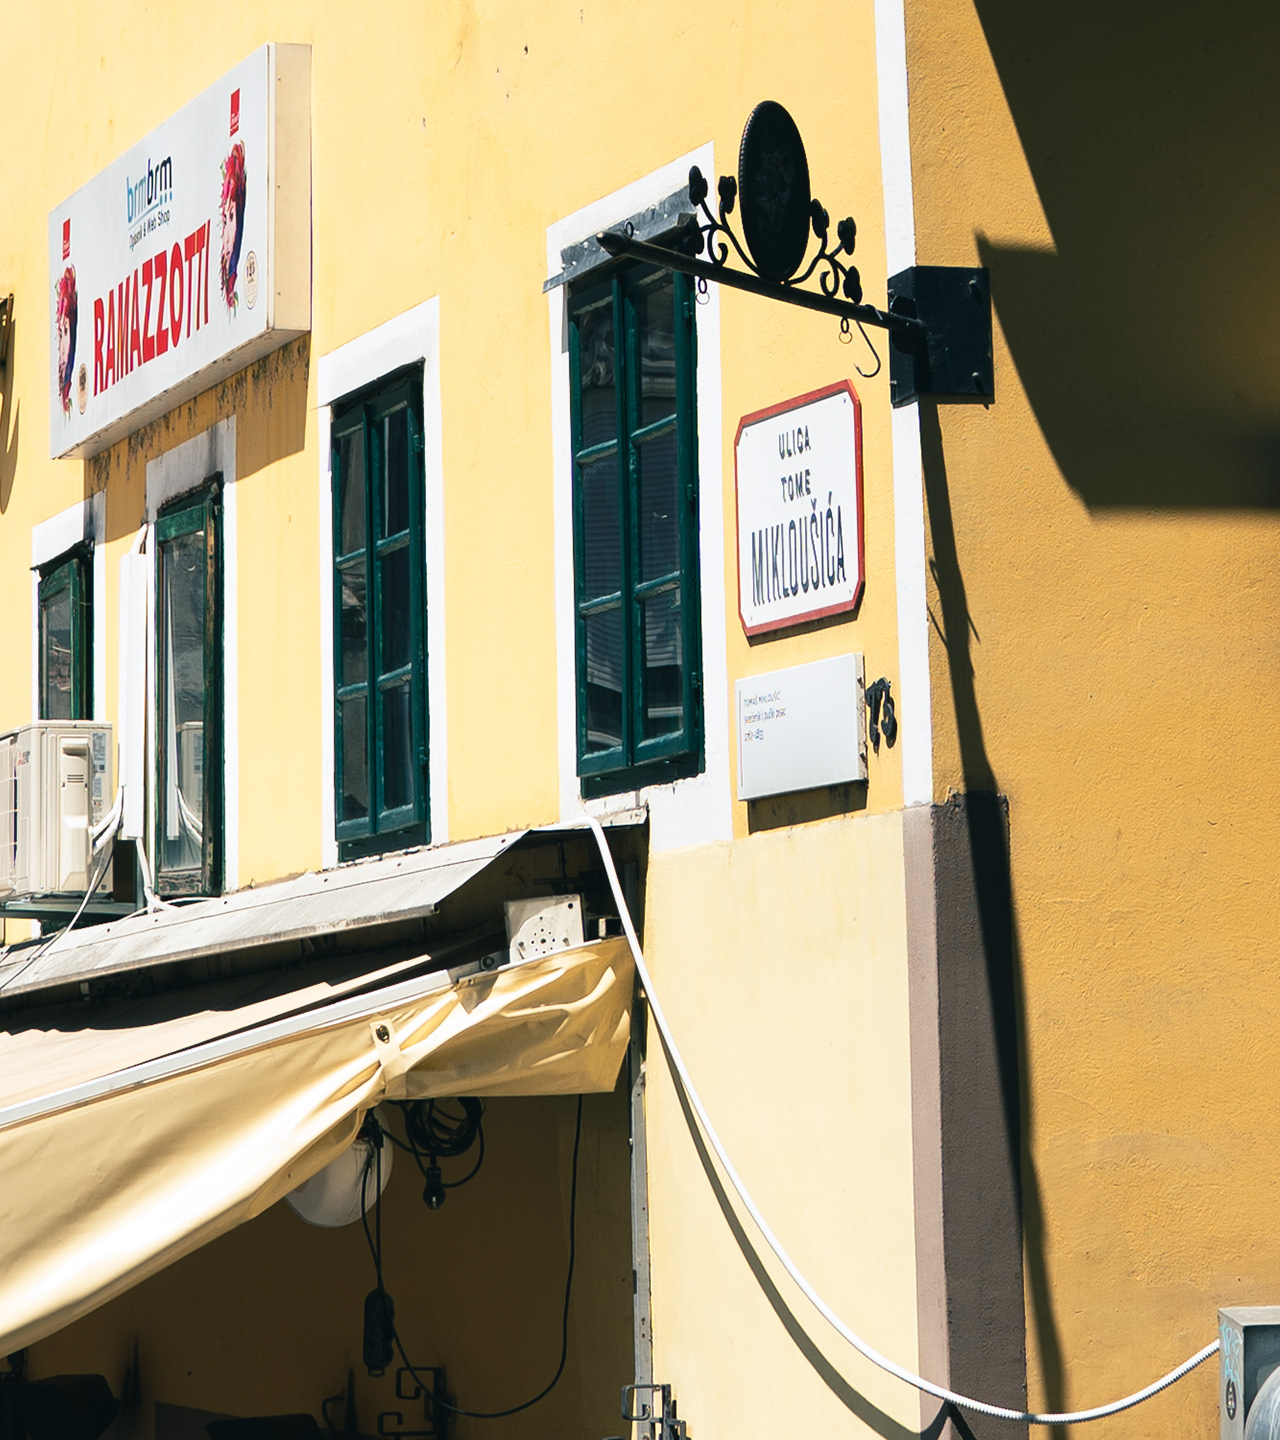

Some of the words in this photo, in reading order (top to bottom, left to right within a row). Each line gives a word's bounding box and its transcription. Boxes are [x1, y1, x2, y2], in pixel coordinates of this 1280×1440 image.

[158, 209, 170, 227] Shop
[93, 217, 211, 397] RAMAZZOTTI
[778, 425, 811, 459] ULICA
[781, 469, 811, 503] TOME
[751, 491, 847, 607] MIKLOUŠIĆA
